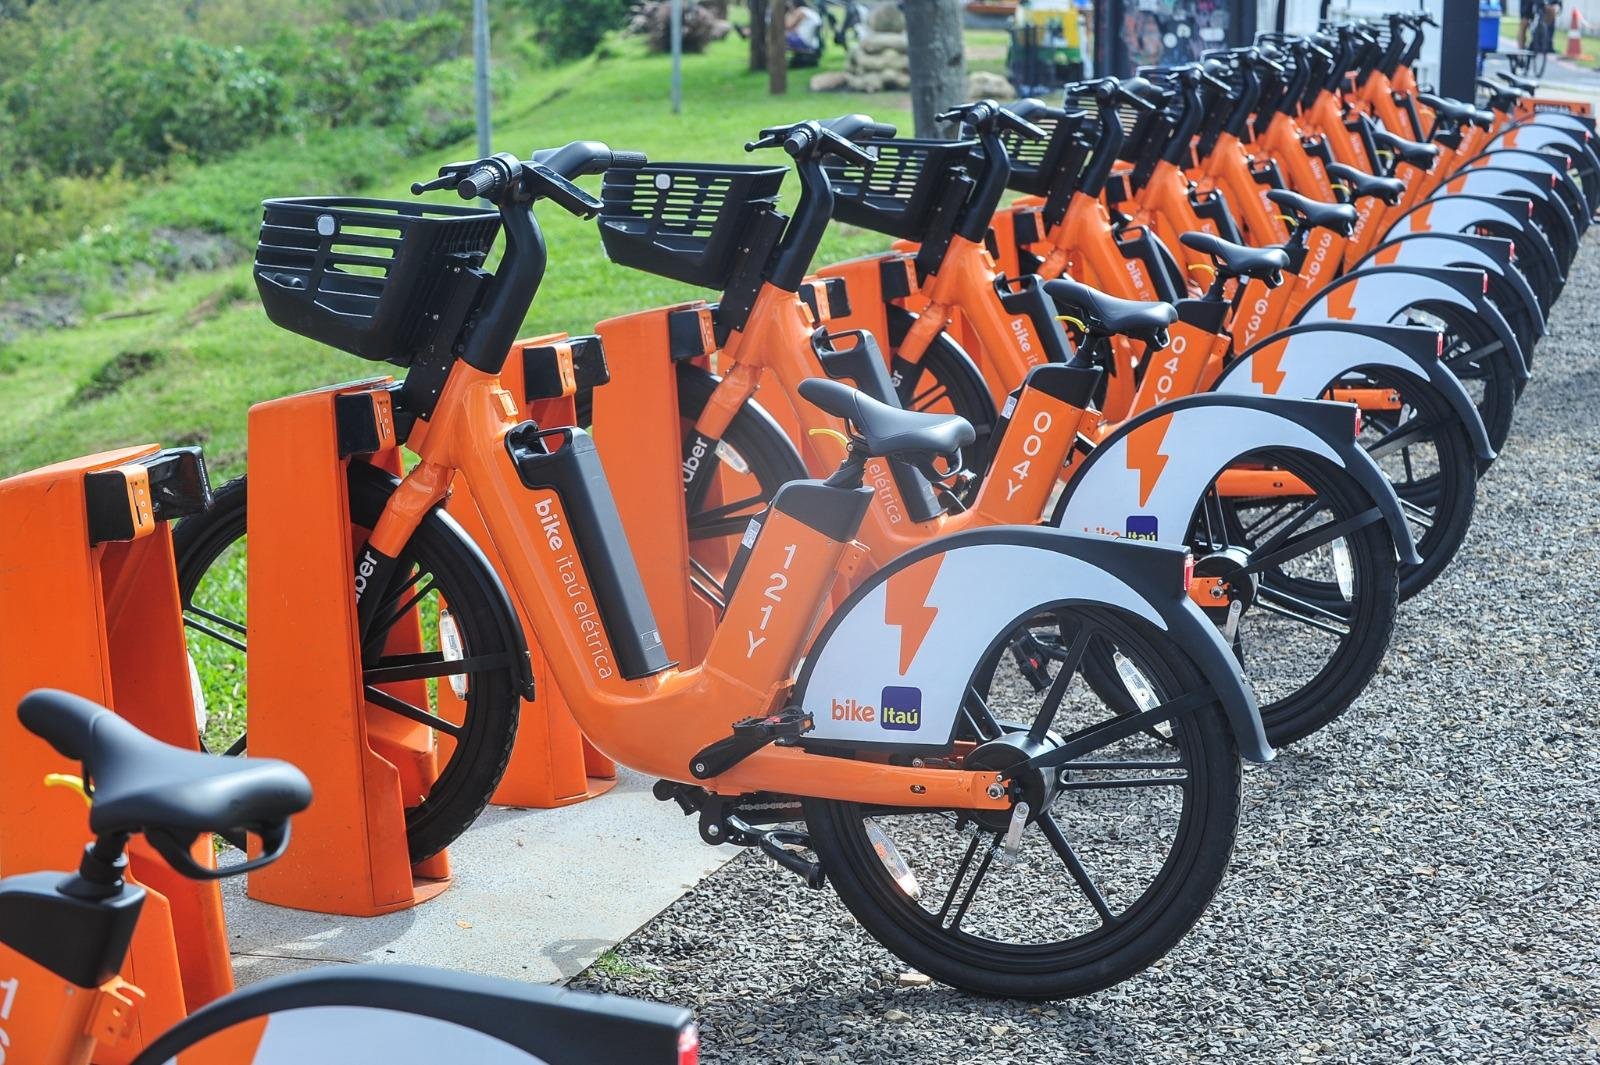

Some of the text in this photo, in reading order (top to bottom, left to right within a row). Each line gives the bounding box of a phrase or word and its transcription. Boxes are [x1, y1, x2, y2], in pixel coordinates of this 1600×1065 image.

[1010, 318, 1032, 352] bike
[1006, 411, 1052, 501] 004Y
[869, 464, 902, 524] elétrica
[355, 550, 378, 605] ber
[534, 498, 613, 680] bike itaú elétrica
[746, 543, 797, 659] 121Y
[831, 698, 919, 725] bike Itaú
